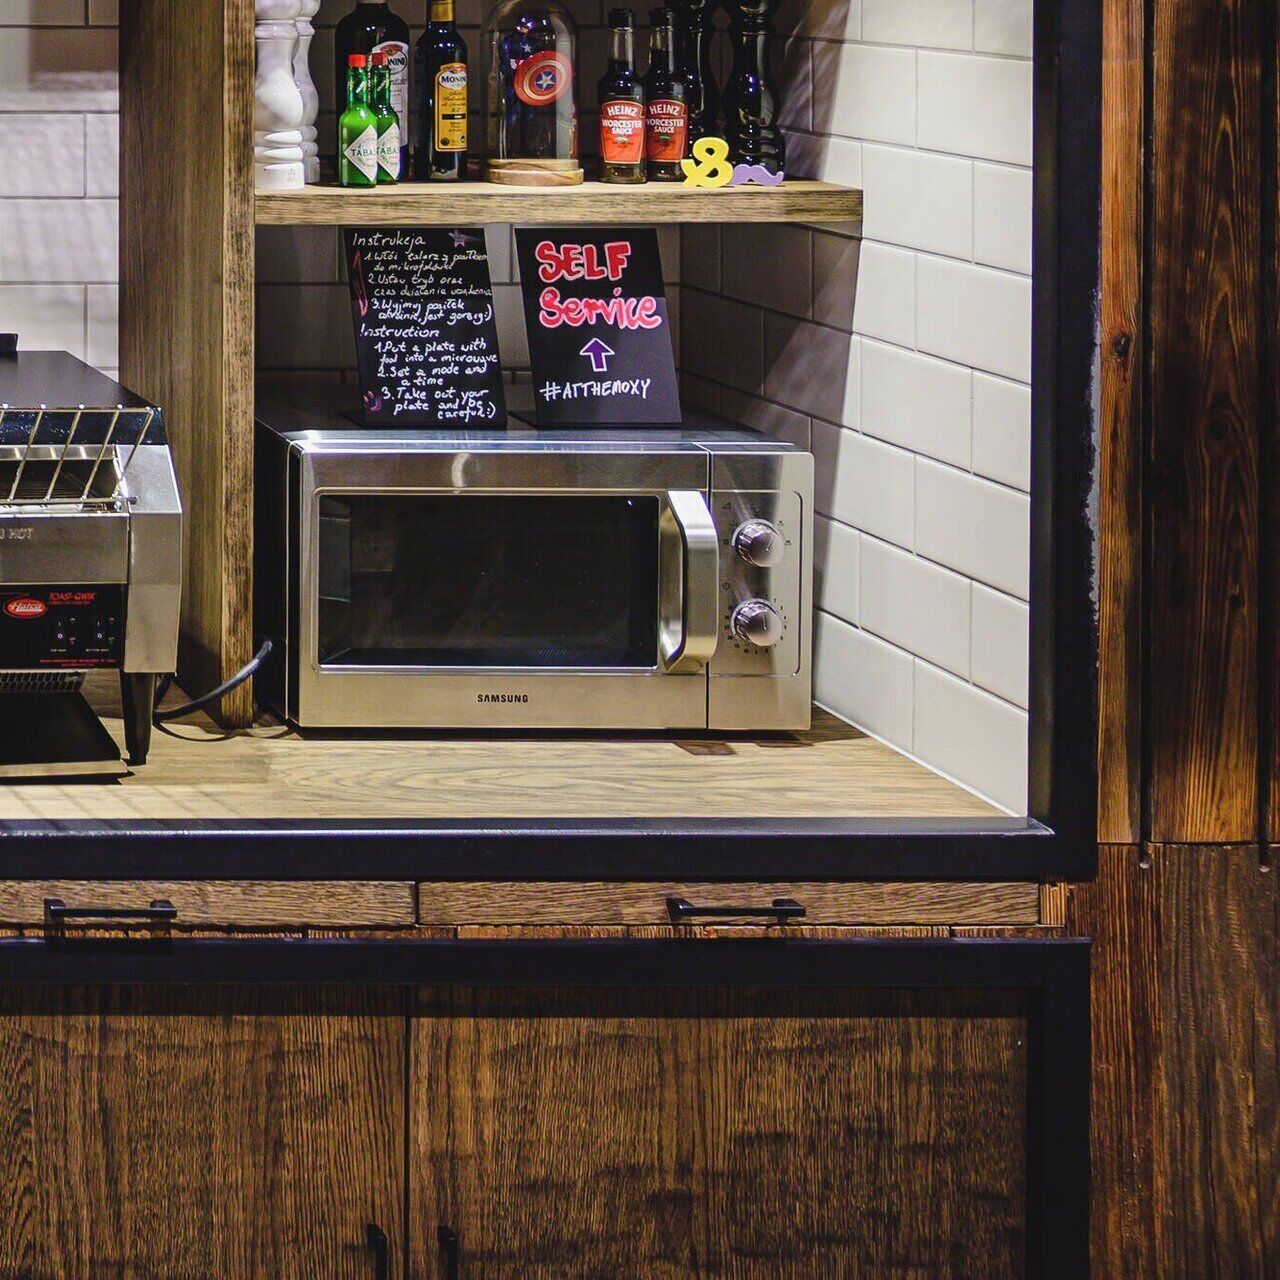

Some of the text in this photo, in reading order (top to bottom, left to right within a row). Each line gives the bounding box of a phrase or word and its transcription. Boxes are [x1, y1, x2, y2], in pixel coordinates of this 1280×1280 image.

[607, 105, 638, 117] HEINZ
[649, 104, 680, 116] HEINZ
[653, 126, 675, 134] SAUCE
[535, 240, 632, 283] SELF
[539, 286, 662, 329] Service
[360, 323, 440, 338] Instruction
[425, 341, 455, 356] plate
[461, 337, 487, 351] with
[405, 353, 424, 363] into
[432, 363, 459, 375] mode
[464, 361, 487, 375] and
[413, 376, 444, 387] time
[434, 386, 457, 399] out
[460, 389, 490, 405] your
[539, 378, 652, 402] #ATTHEMOXY
[393, 400, 430, 416] plate
[437, 399, 459, 409] and
[477, 694, 529, 703] SAMSUNG
